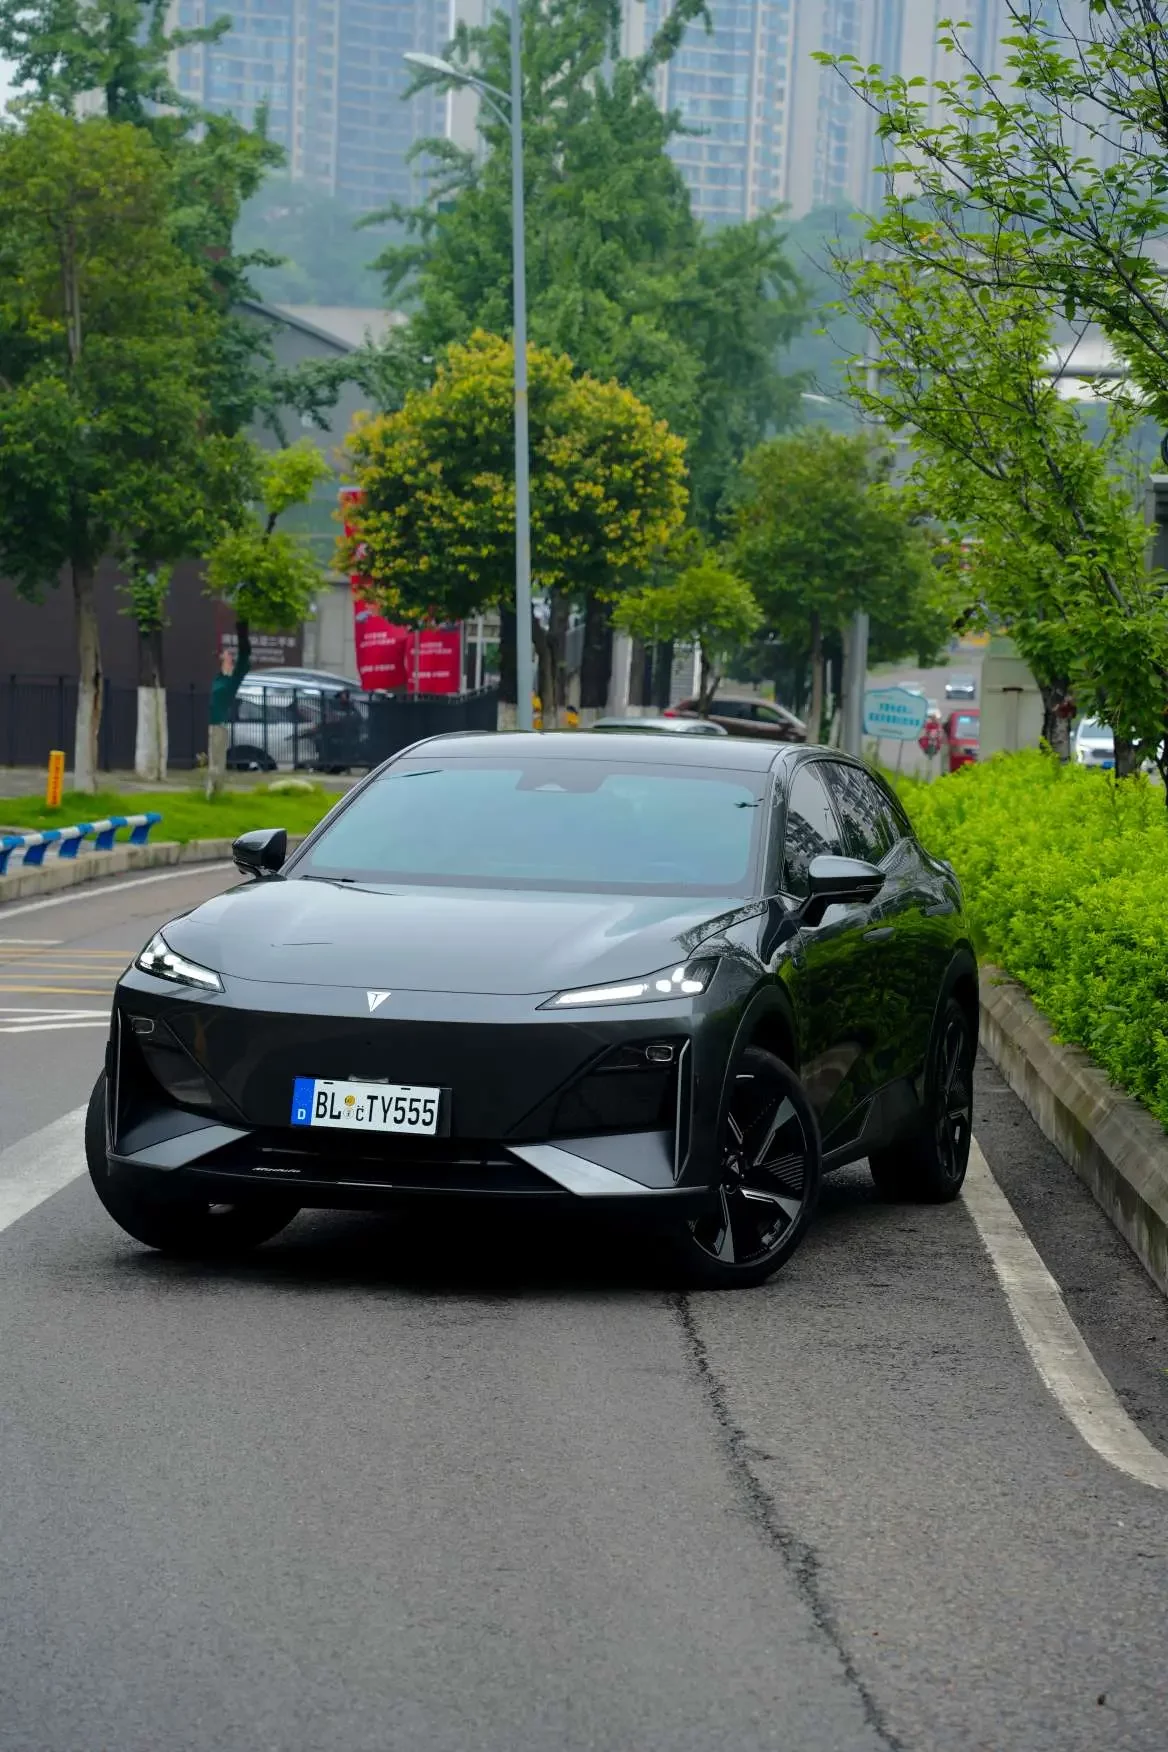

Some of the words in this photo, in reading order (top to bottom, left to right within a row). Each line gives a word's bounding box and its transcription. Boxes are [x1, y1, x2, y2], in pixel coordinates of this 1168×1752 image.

[297, 1108, 306, 1120] D
[316, 1091, 341, 1120] BL
[366, 1094, 436, 1127] TY555
